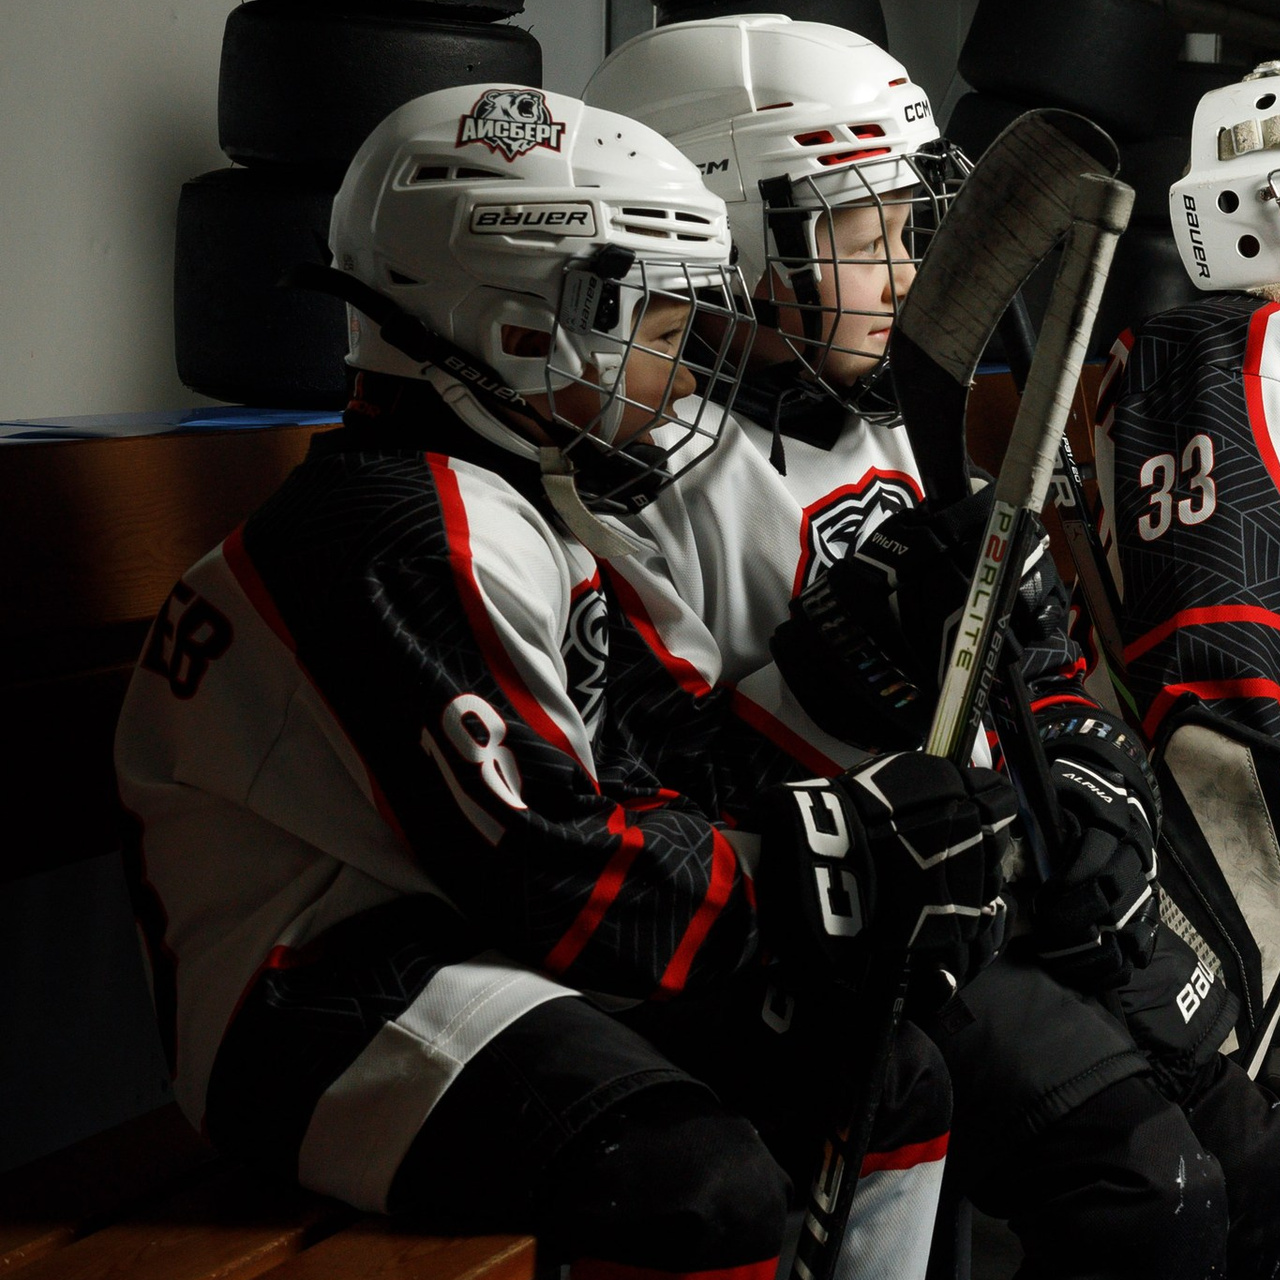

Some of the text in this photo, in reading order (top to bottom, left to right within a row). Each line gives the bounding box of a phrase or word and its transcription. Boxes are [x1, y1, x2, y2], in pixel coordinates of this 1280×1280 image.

[904, 100, 931, 122] CCM
[699, 159, 729, 175] CM
[476, 211, 588, 226] BAUER
[1183, 194, 1211, 278] BAUER
[579, 276, 597, 330] BAUER
[1137, 433, 1218, 543] 33
[871, 531, 910, 556] ALPHA
[955, 508, 1013, 671] P2RLITE
[969, 629, 1003, 728] BAUER
[420, 692, 529, 848] 18
[1062, 773, 1113, 804] ALPHA
[784, 777, 863, 938] CC
[1176, 958, 1214, 1024] BAU
